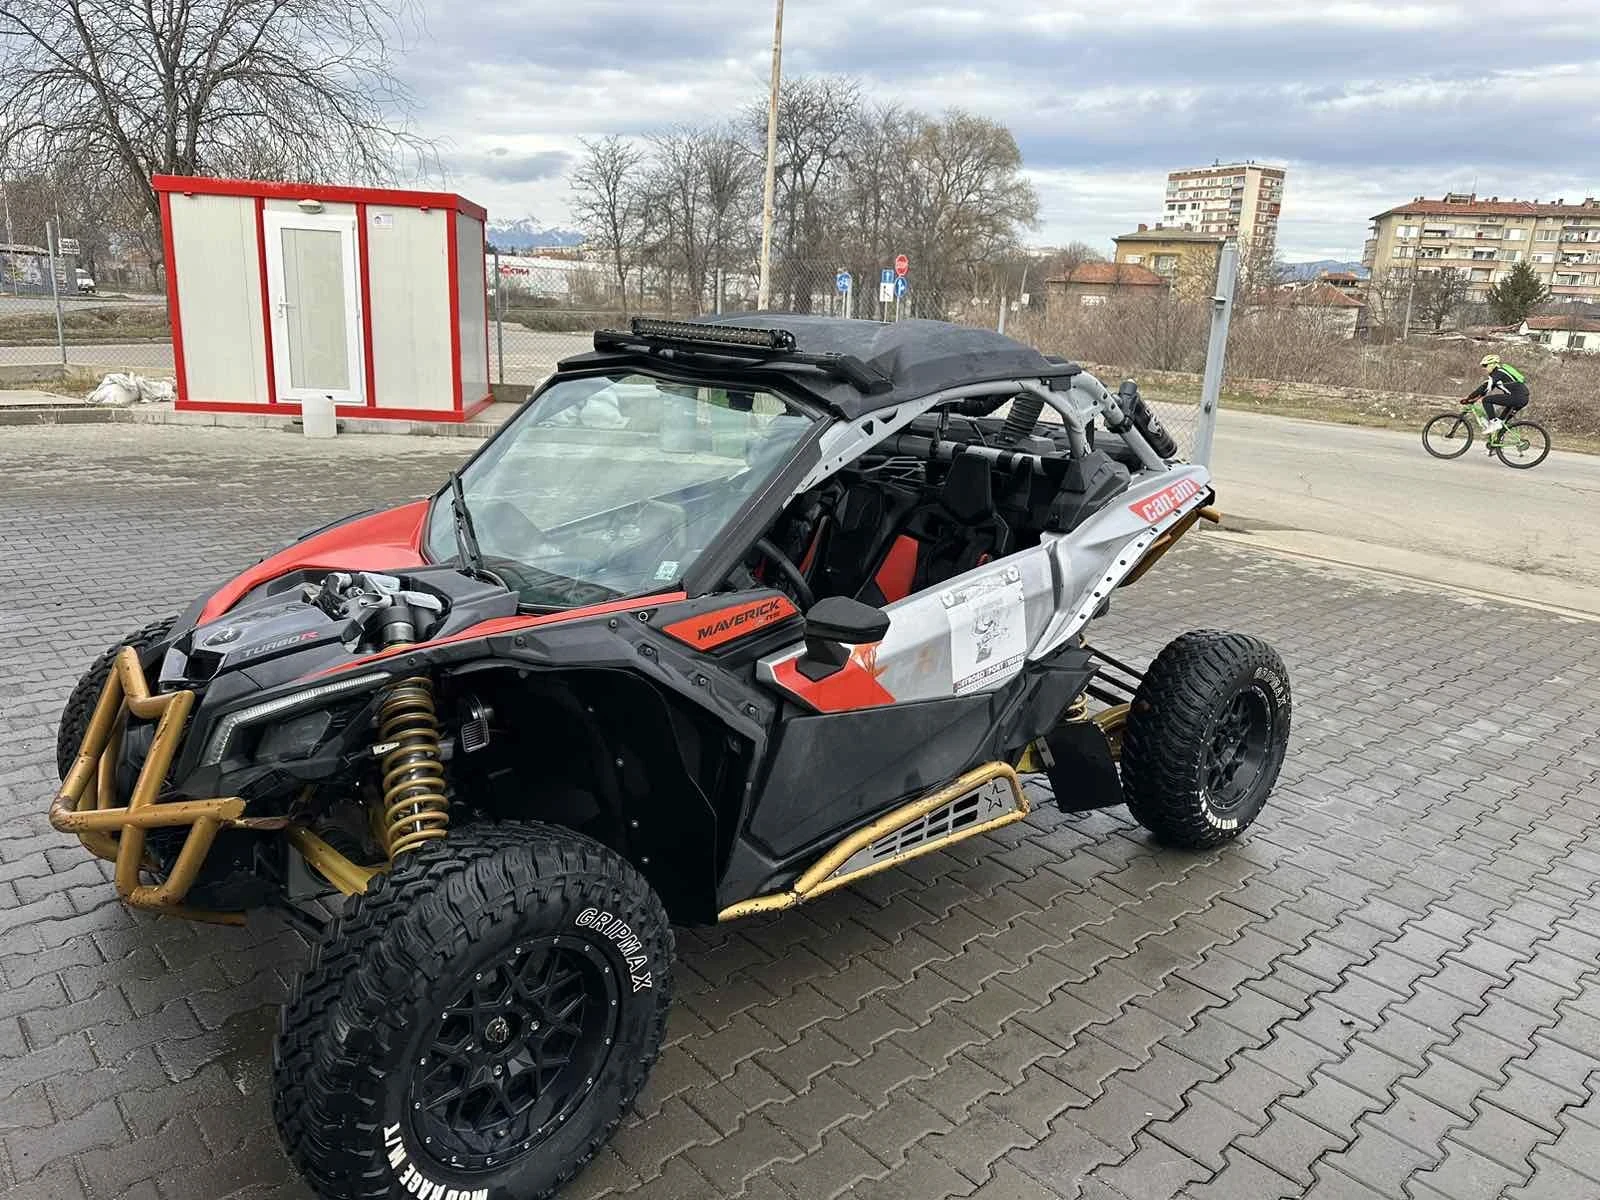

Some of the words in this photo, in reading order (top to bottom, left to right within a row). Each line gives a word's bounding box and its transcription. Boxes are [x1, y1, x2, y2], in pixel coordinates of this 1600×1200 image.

[697, 599, 781, 640] MAVERICK
[575, 907, 653, 993] GRIPMAX
[383, 1121, 408, 1170] M/T
[398, 1162, 447, 1200] RAGE
